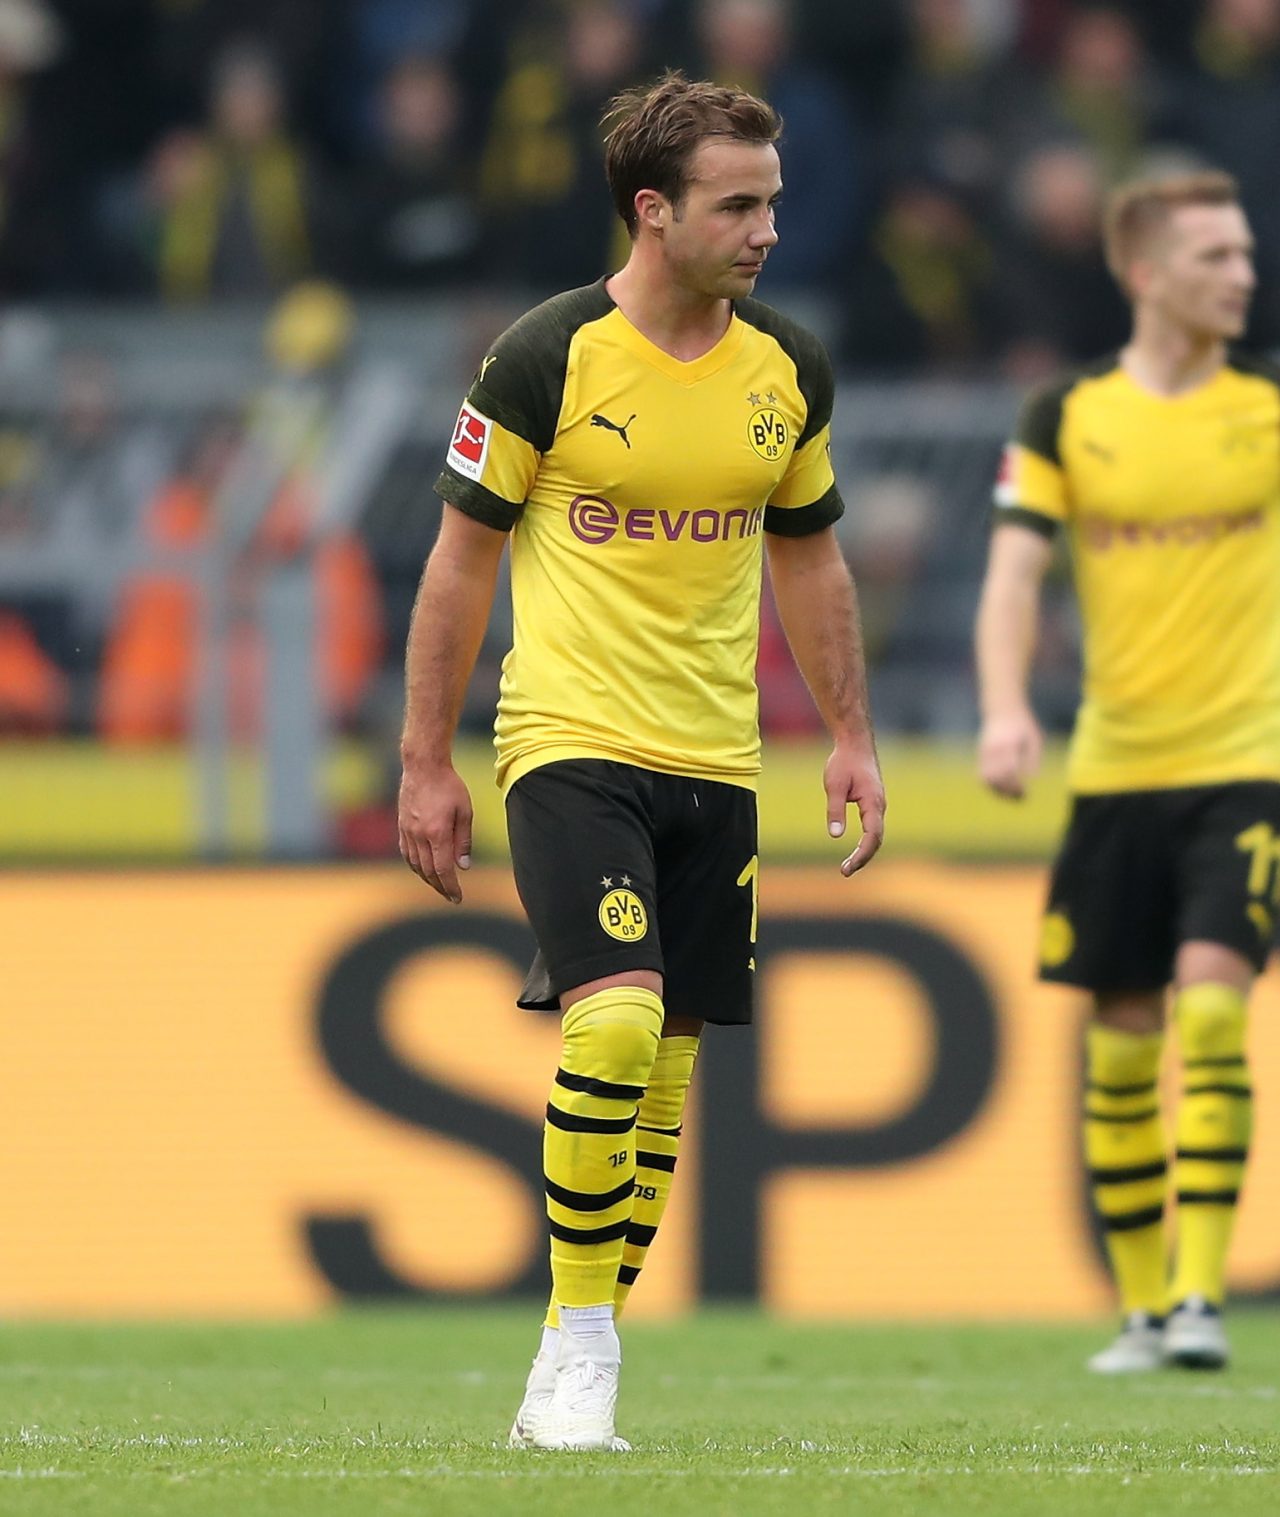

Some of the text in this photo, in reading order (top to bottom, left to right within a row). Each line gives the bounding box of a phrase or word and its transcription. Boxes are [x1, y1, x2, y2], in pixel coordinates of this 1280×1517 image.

[753, 413, 786, 446] BVB
[766, 445, 778, 457] 09
[606, 895, 643, 927] BVB
[622, 924, 636, 936] 09
